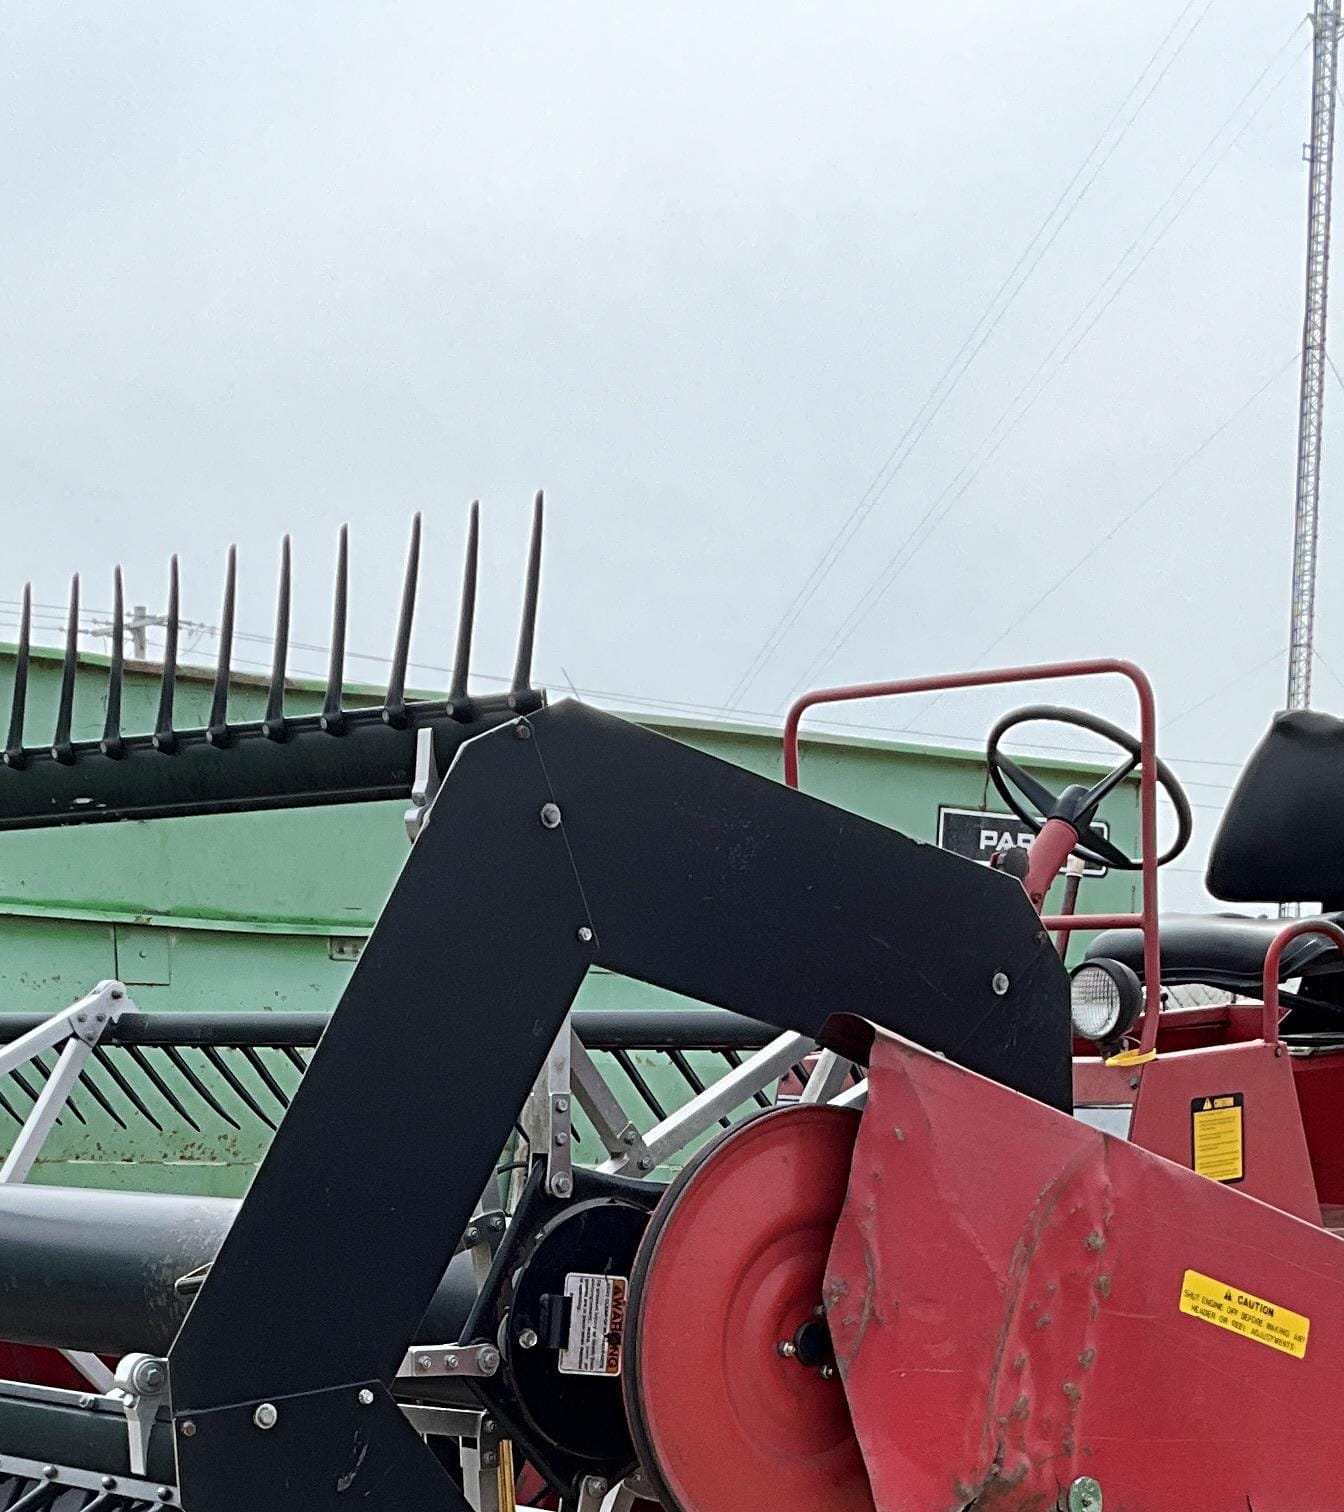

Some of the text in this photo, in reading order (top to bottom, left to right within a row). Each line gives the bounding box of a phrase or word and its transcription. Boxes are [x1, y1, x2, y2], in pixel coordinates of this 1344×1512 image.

[1183, 1289, 1200, 1301] SHUT
[1201, 1296, 1223, 1311] ENGINE
[1226, 1306, 1239, 1316] OFF
[1240, 1311, 1263, 1327] BEFORE
[1266, 1320, 1291, 1338] MAKING
[1191, 1304, 1295, 1351] HEADER OR REEL ADJUSTMENTS
[1237, 1295, 1275, 1317] CAUTION
[607, 1296, 625, 1369] WARNG
